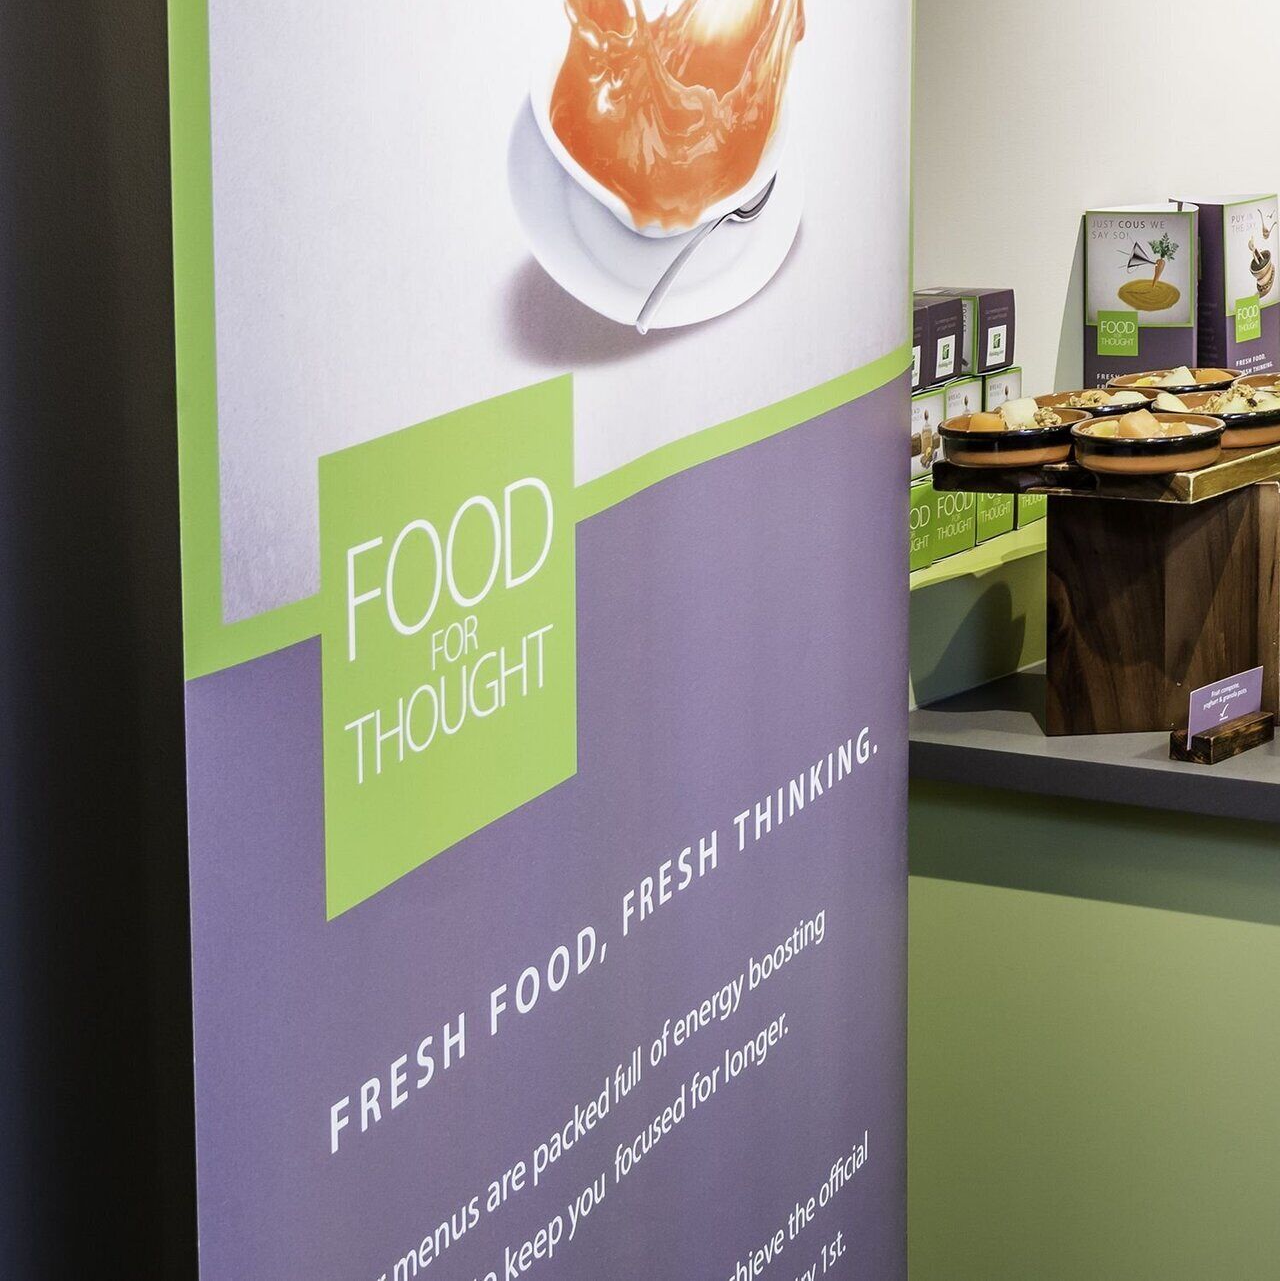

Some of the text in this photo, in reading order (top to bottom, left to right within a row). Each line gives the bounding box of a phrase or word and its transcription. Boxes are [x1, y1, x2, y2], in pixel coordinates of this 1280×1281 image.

[1092, 220, 1165, 230] JUST COUS WE
[1092, 231, 1109, 240] SAY
[1101, 321, 1134, 334] FOOD
[1237, 304, 1259, 320] FOOD
[1101, 338, 1134, 346] THOUGHT
[937, 492, 973, 519] FOOD
[980, 502, 1012, 523] THOUGHT
[937, 517, 973, 540] THOUGHT
[346, 476, 553, 662] FOOD
[432, 614, 479, 671] FOR
[344, 624, 554, 785] THOUGHT
[331, 726, 880, 1155] FRESH FOOD, FRESH THINKING.
[394, 909, 826, 1281] menus are packed full of energy boosting
[504, 1010, 789, 1281] keep you focused for longer.
[787, 1196, 816, 1241] the
[818, 1129, 868, 1208] official
[820, 1230, 847, 1274] 1st.
